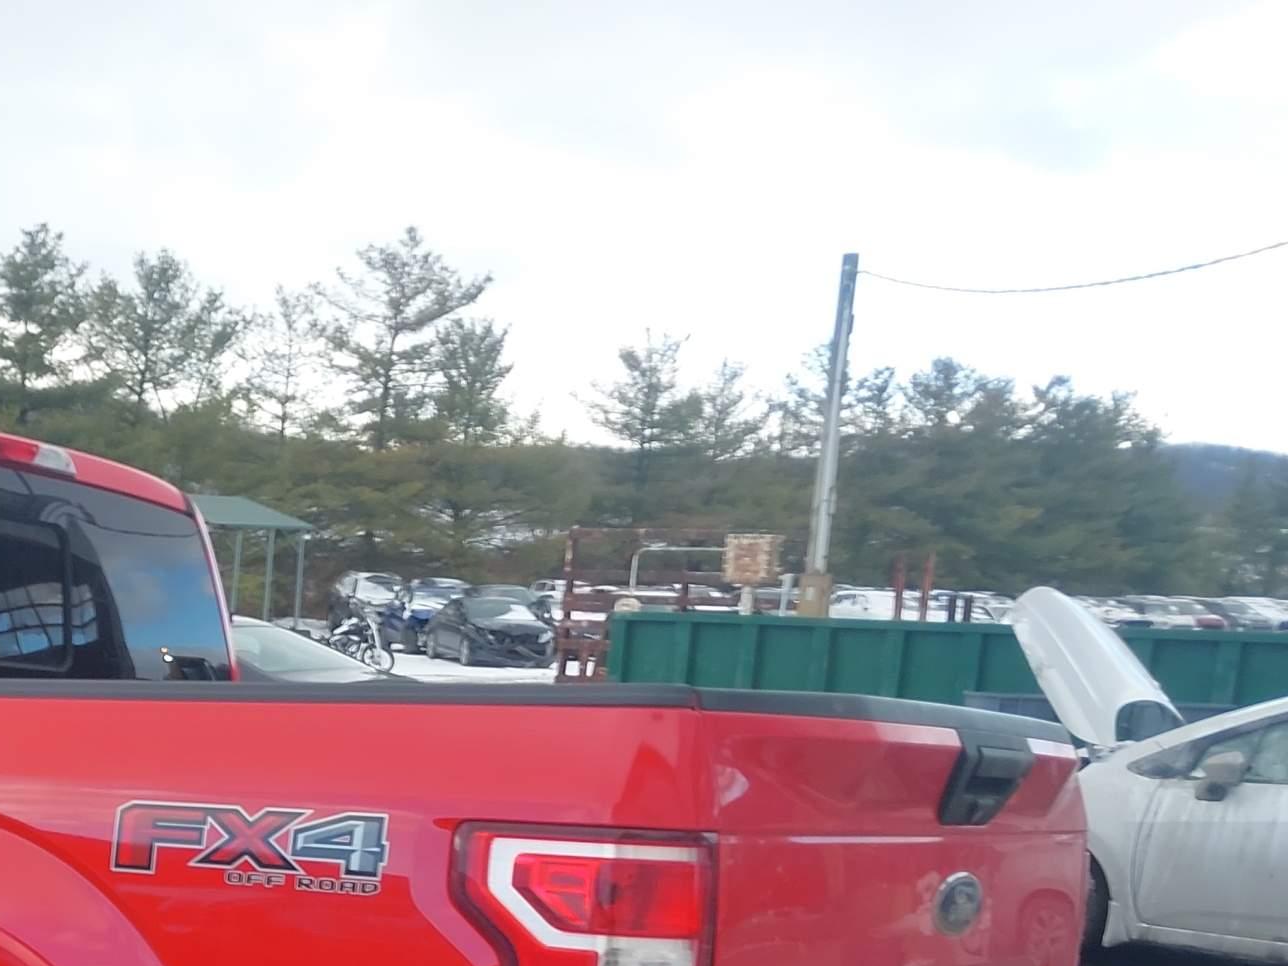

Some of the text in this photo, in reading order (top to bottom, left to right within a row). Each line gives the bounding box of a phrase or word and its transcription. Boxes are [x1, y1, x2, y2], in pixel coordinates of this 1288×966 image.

[110, 799, 390, 881] FX4
[224, 871, 382, 896] OFF ROAD
